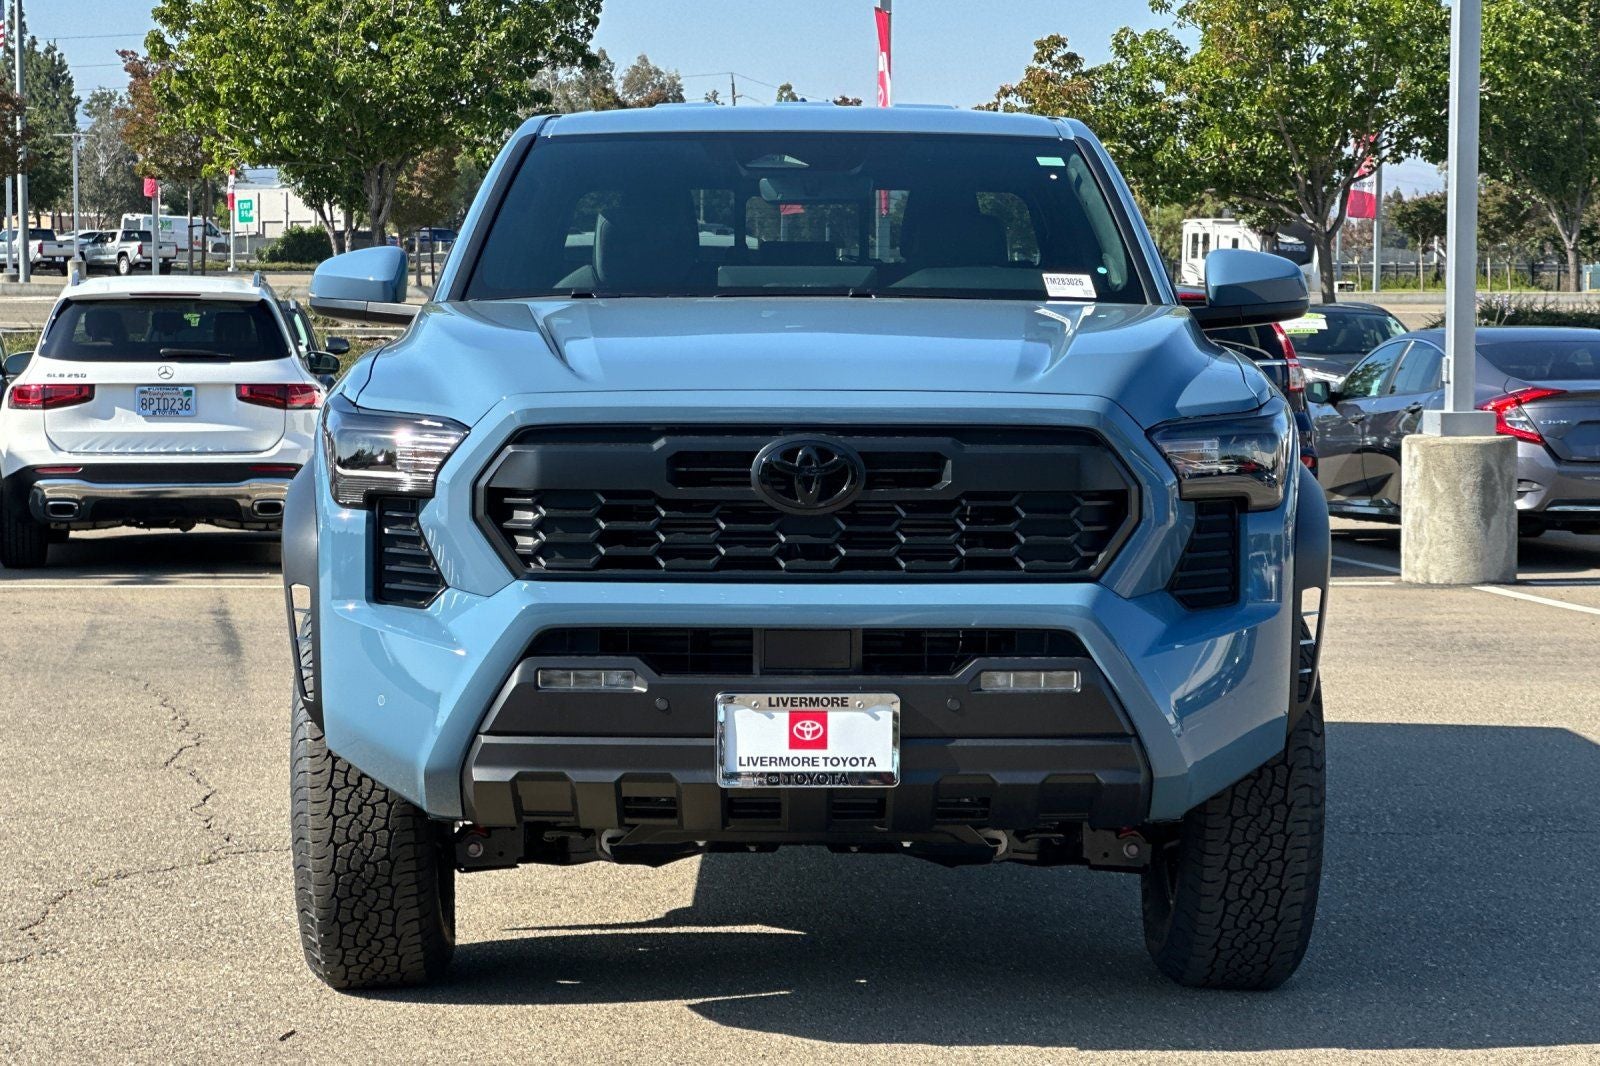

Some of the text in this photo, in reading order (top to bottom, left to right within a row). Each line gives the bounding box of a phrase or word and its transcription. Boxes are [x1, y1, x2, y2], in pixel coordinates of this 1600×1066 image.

[1045, 276, 1084, 286] TM283026
[141, 397, 191, 411] 8PID236
[768, 697, 849, 708] LIVERMORE
[738, 756, 877, 767] LIVERMORE TOYOTA
[785, 773, 850, 785] TOYOTA
